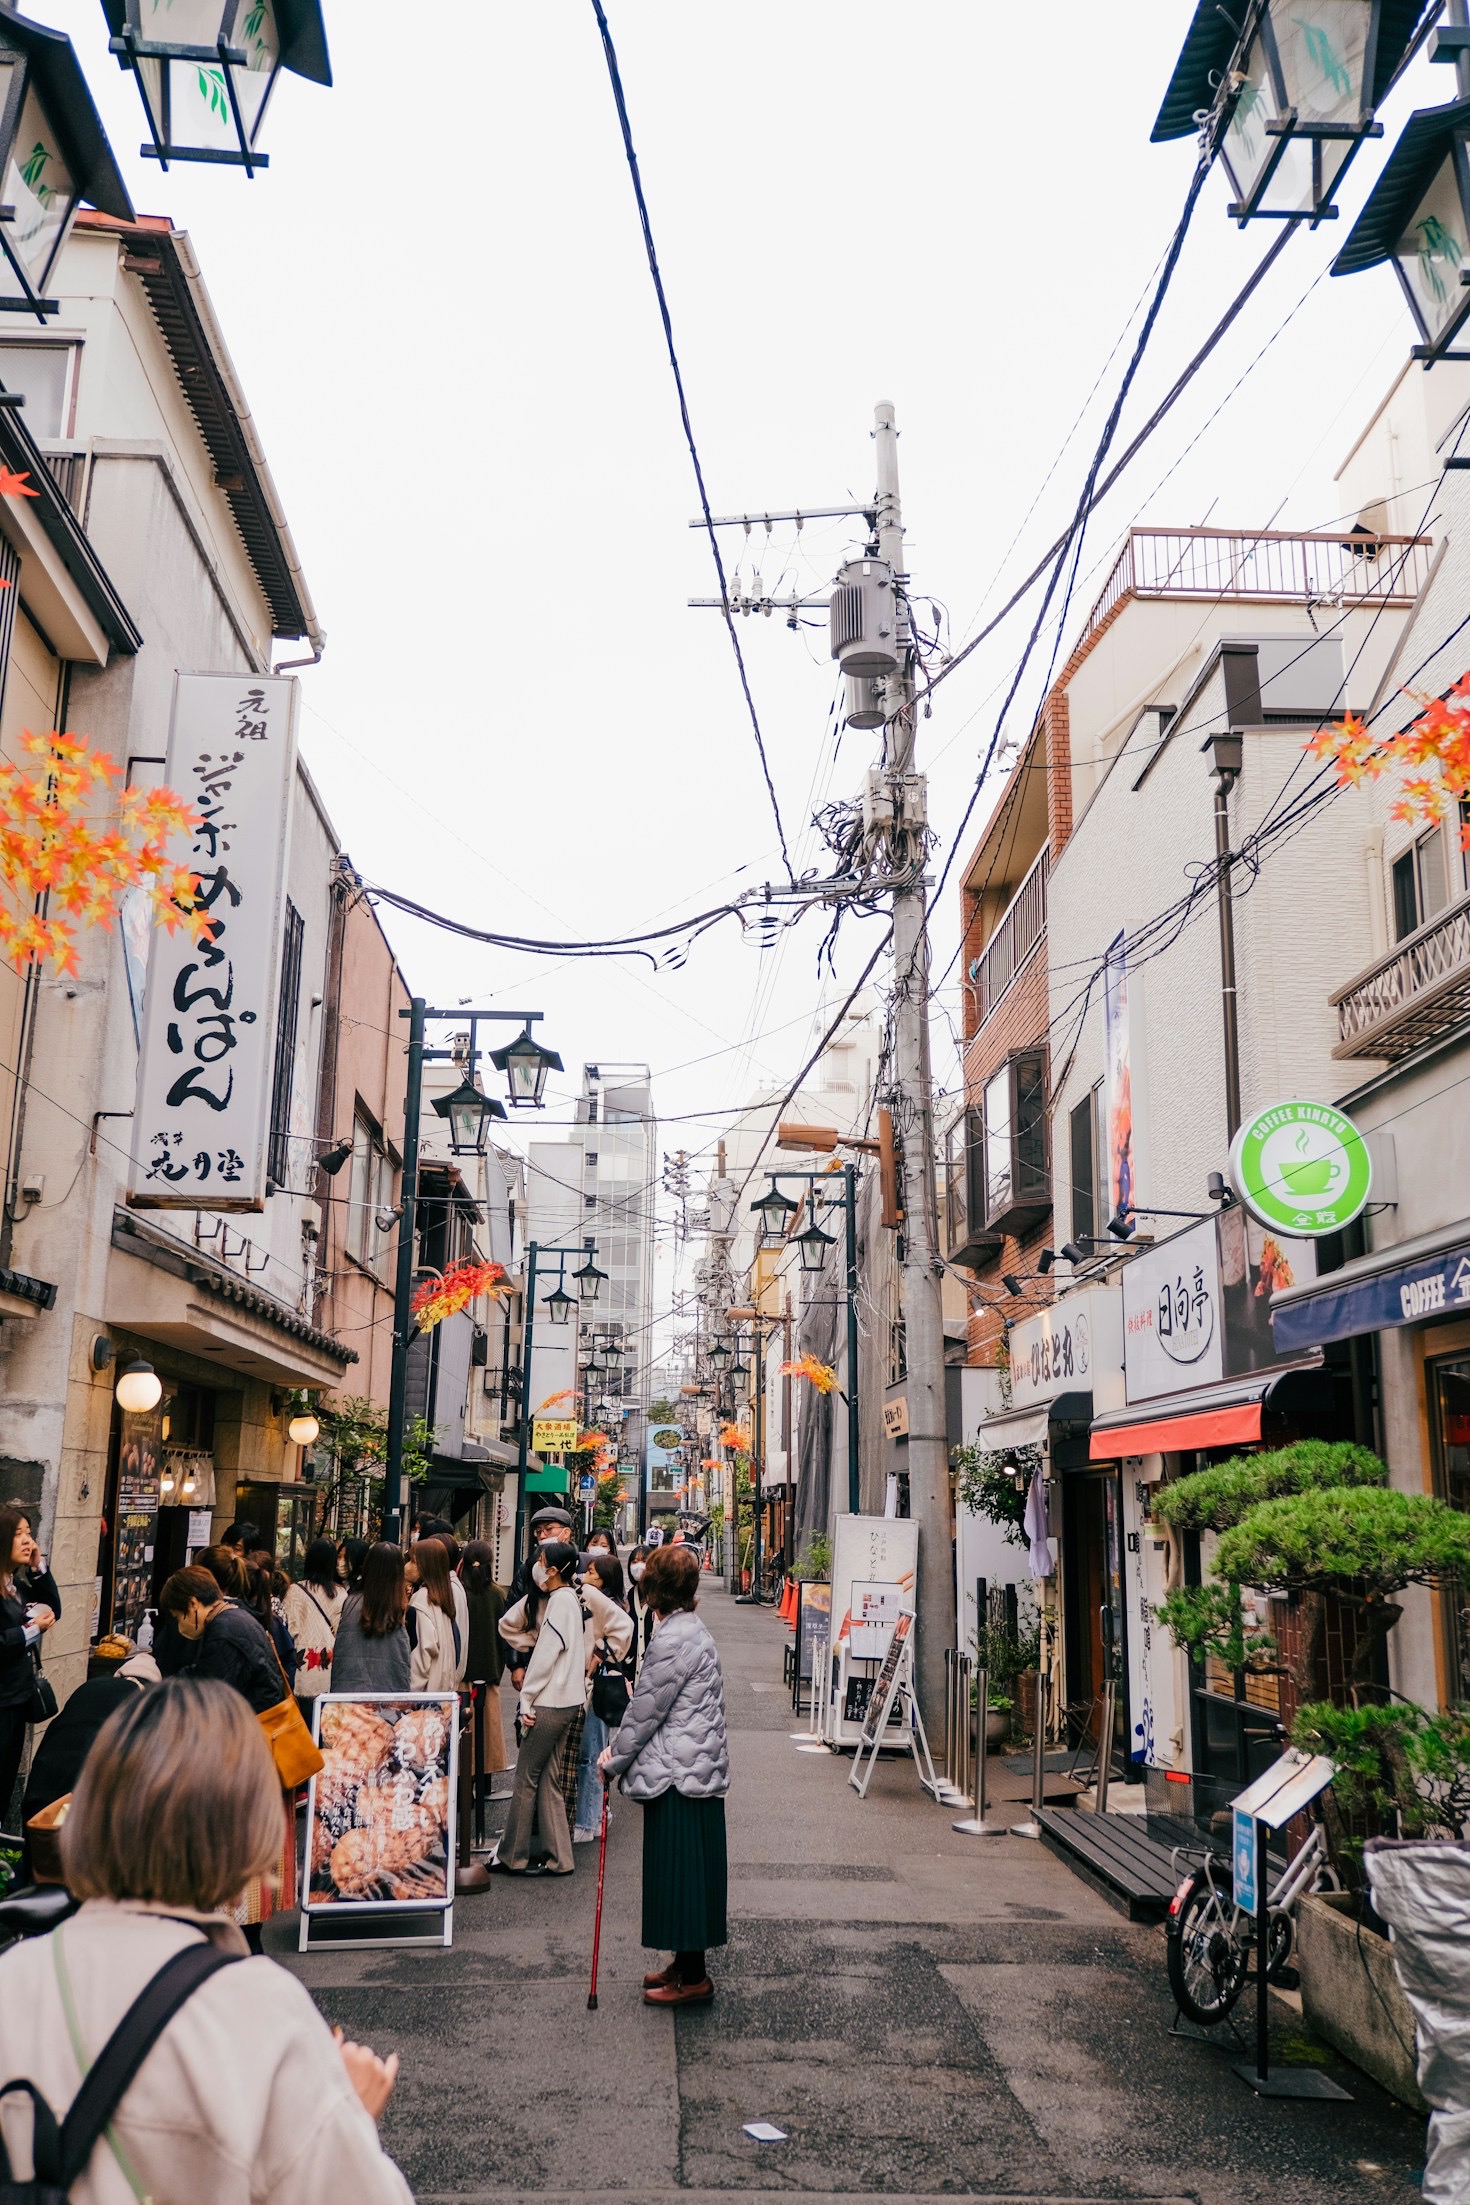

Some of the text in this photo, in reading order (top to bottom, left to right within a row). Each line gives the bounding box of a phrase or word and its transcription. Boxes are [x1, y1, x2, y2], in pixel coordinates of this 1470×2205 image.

[235, 688, 270, 742] 元祖
[1251, 1106, 1347, 1140] COFFEE KINRYU
[145, 1149, 245, 1182] 花月堂
[1158, 1265, 1210, 1337] 日向亭
[1400, 1273, 1445, 1318] COFFEE
[1030, 1324, 1075, 1387] ひなと丸
[420, 1718, 445, 1828] ありえない
